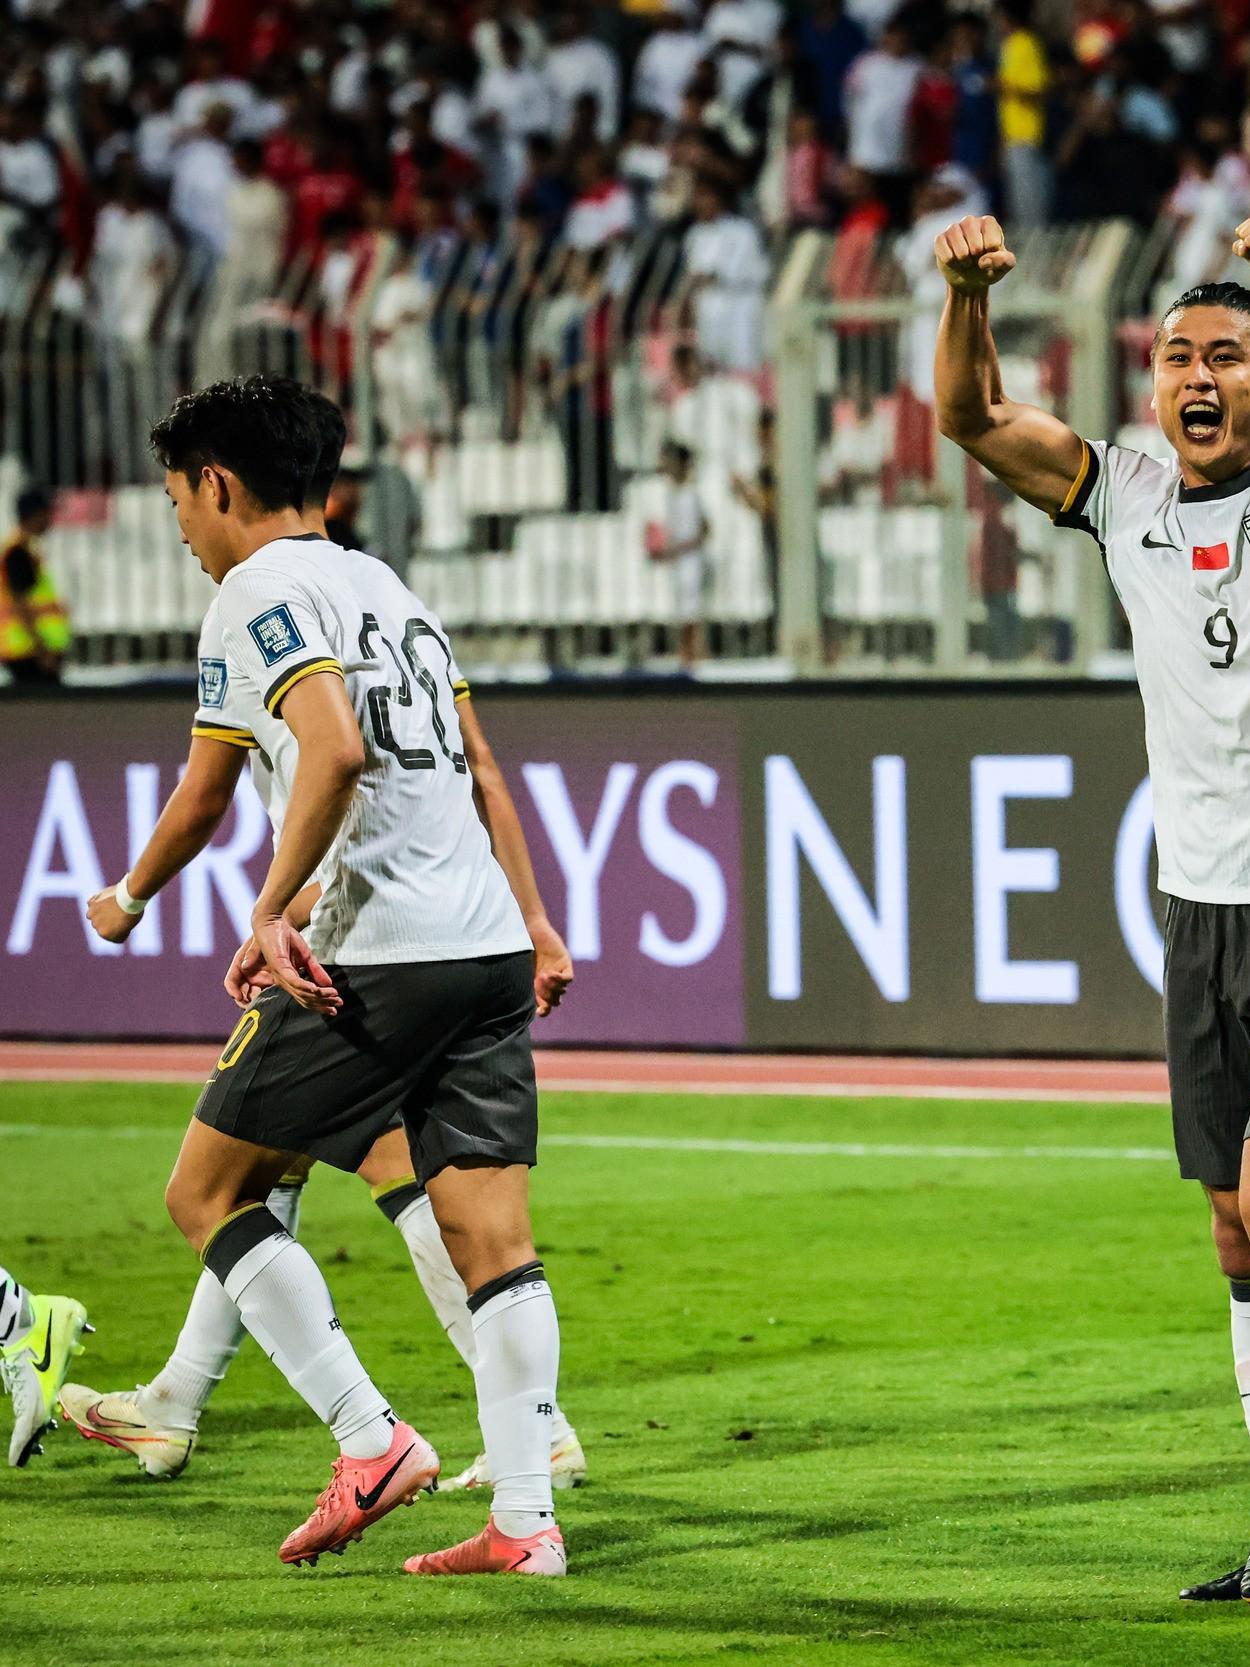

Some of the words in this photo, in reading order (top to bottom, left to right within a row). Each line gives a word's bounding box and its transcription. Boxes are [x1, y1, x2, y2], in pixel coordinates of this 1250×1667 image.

[257, 615, 283, 632] FOOTBALL
[260, 621, 286, 641] UNITES
[1203, 607, 1238, 669] 9
[358, 612, 467, 775] 20
